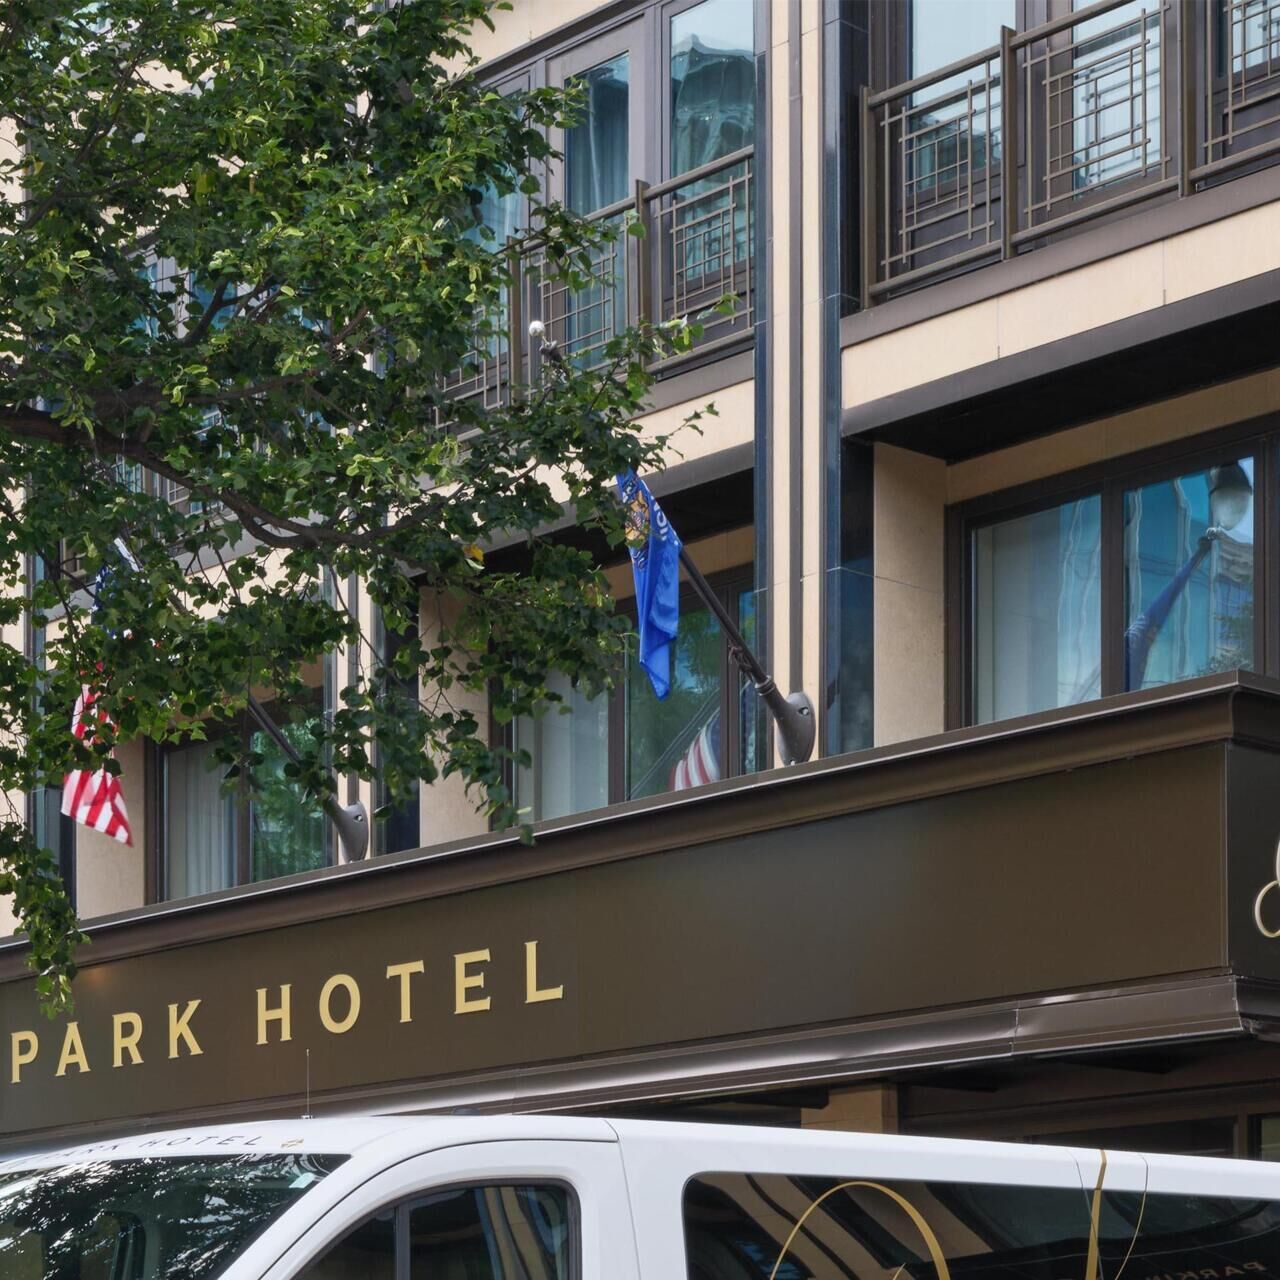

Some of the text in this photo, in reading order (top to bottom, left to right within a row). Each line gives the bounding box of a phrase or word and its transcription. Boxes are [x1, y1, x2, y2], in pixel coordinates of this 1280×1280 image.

[10, 940, 564, 1084] PARK HOTEL
[139, 1135, 263, 1148] HOTEL
